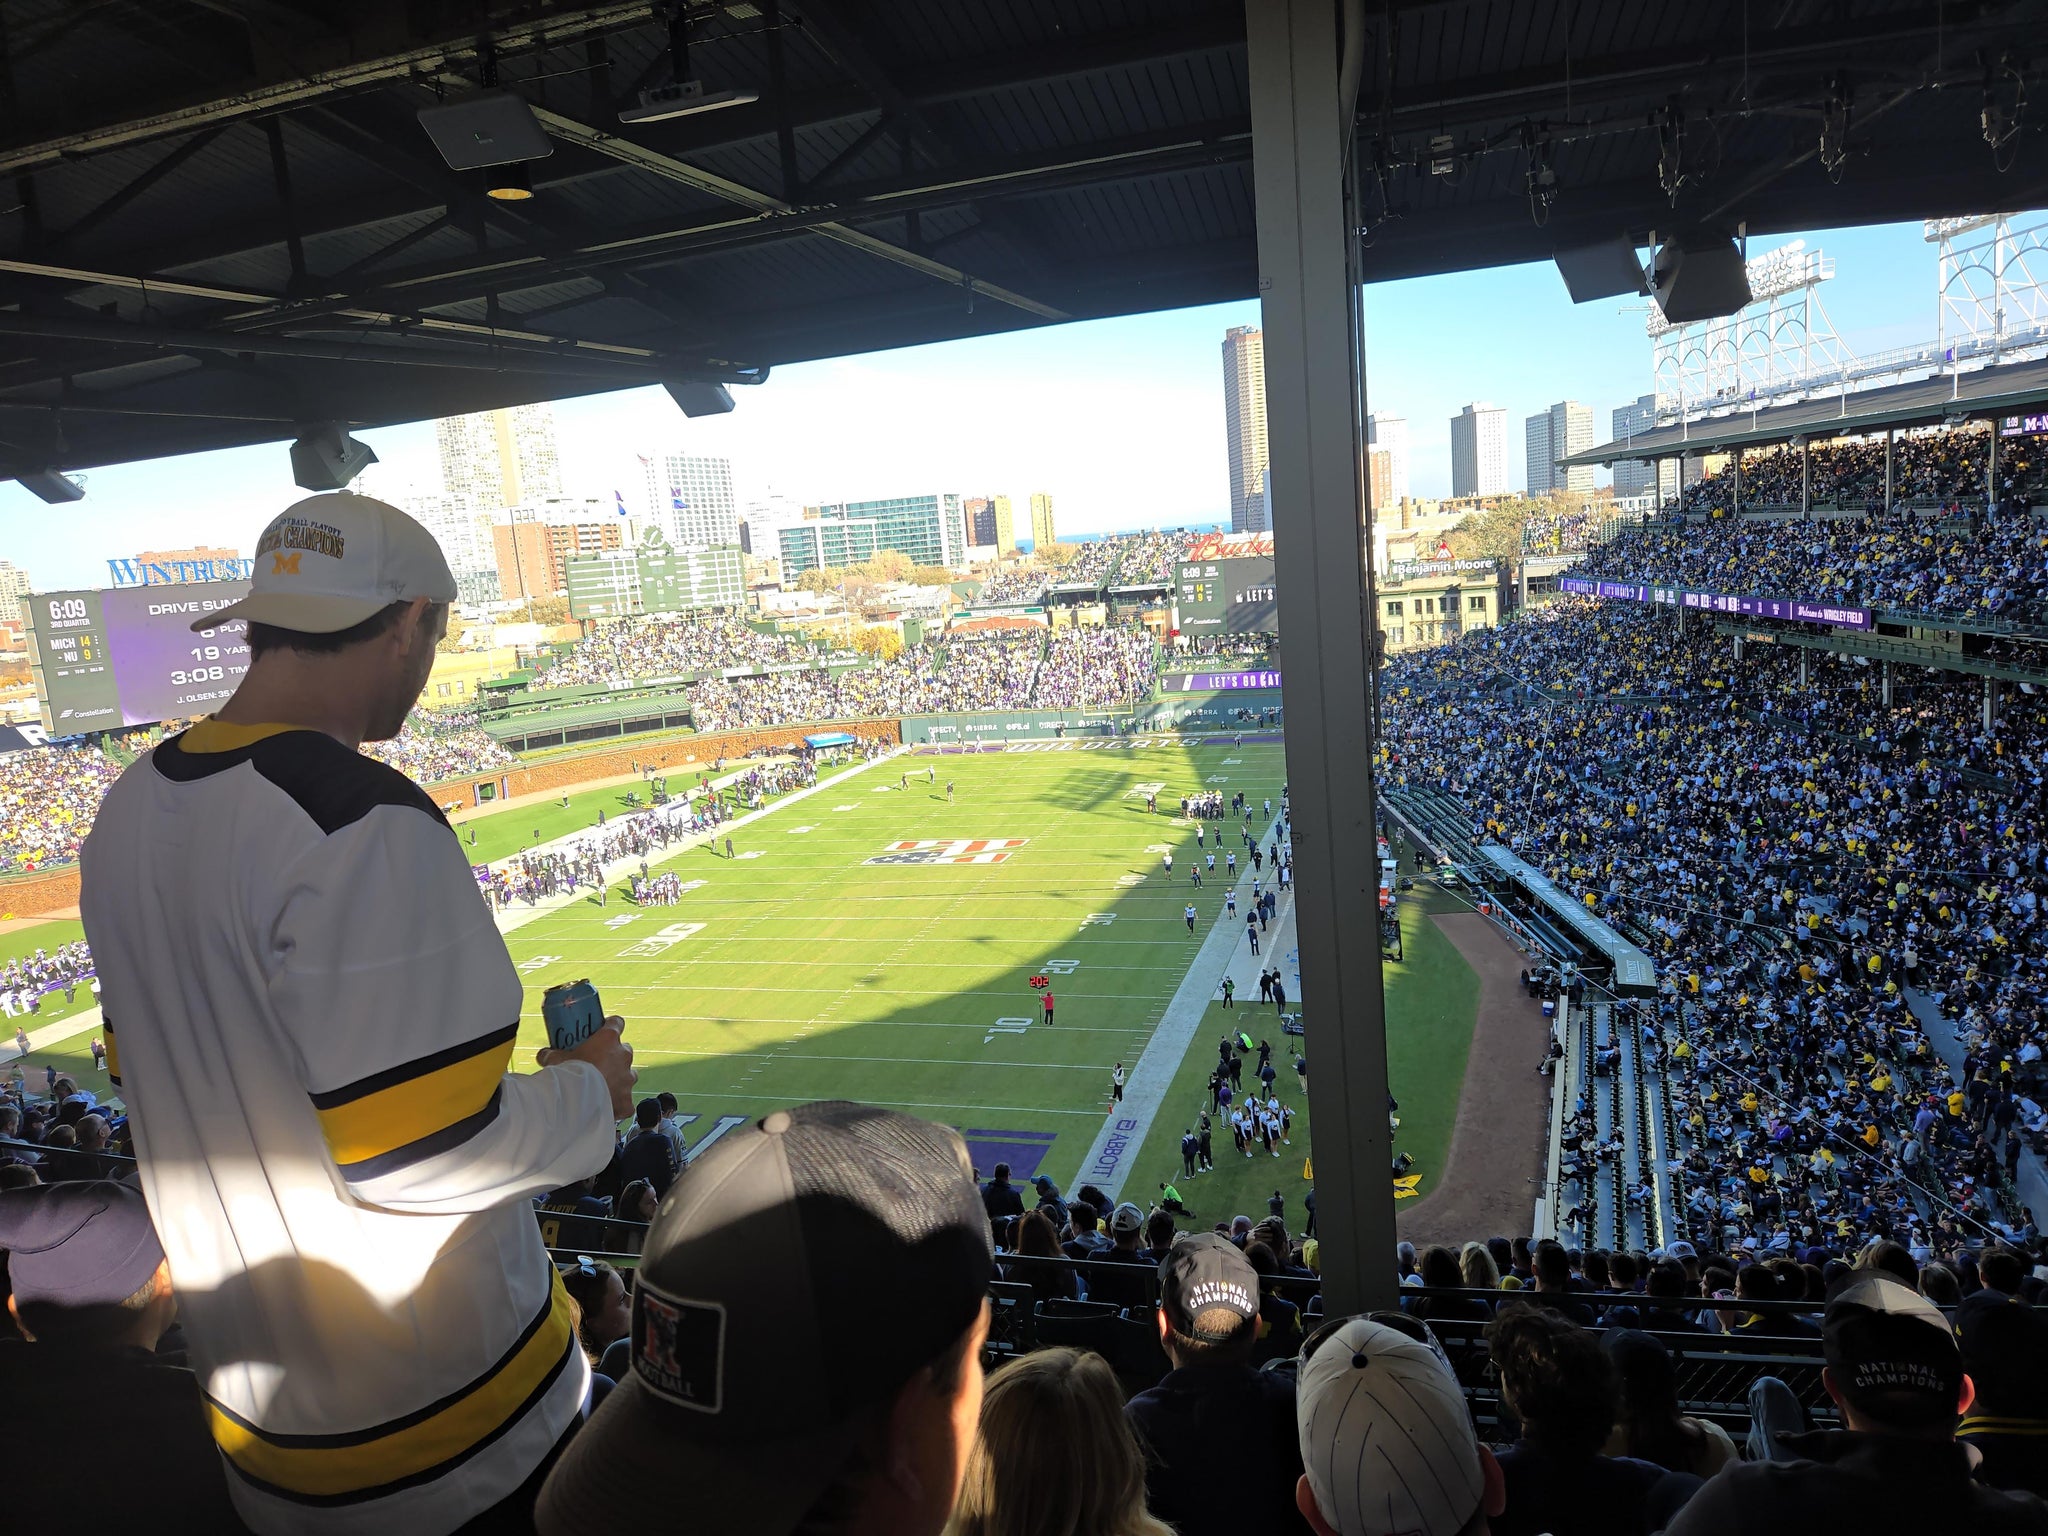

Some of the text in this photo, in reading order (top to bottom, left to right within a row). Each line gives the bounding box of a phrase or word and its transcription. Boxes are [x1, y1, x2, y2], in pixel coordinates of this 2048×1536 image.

[310, 521, 342, 536] PLAYOFF
[284, 525, 345, 560] CHAMPIONS
[271, 551, 303, 575] M
[1399, 559, 1493, 575] Benjamin Moore
[107, 558, 255, 586] WINTRUST
[1182, 567, 1200, 578] 6:09
[1246, 588, 1274, 603] LET'S
[49, 599, 87, 620] 6:09
[148, 598, 243, 616] DRIVE SUM
[1798, 605, 1817, 618] Welcome
[1823, 608, 1846, 622] WRIGLEY
[1847, 610, 1863, 624] FIELD
[63, 619, 90, 627] QUARTER
[50, 635, 91, 650] MICH 14
[64, 649, 91, 662] NU 9
[190, 645, 220, 661] 19
[170, 666, 225, 685] 3:08
[227, 665, 250, 675] TIM
[1209, 676, 1238, 688] LET'S
[1242, 675, 1257, 687] GO
[176, 696, 185, 704] J.
[186, 692, 217, 703] OLSEN:
[218, 689, 230, 698] 35
[74, 707, 114, 718] Constellation
[1006, 738, 1202, 753] WILDCATS
[1039, 959, 1081, 974] 20
[555, 1012, 593, 1050] Cold
[988, 1017, 1034, 1034] 10
[1091, 1132, 1130, 1178] ABBOTT
[1193, 1280, 1248, 1300] NATIONAL
[1189, 1292, 1253, 1313] CHAMPIONS
[1855, 1373, 1945, 1392] CHAMPIONS
